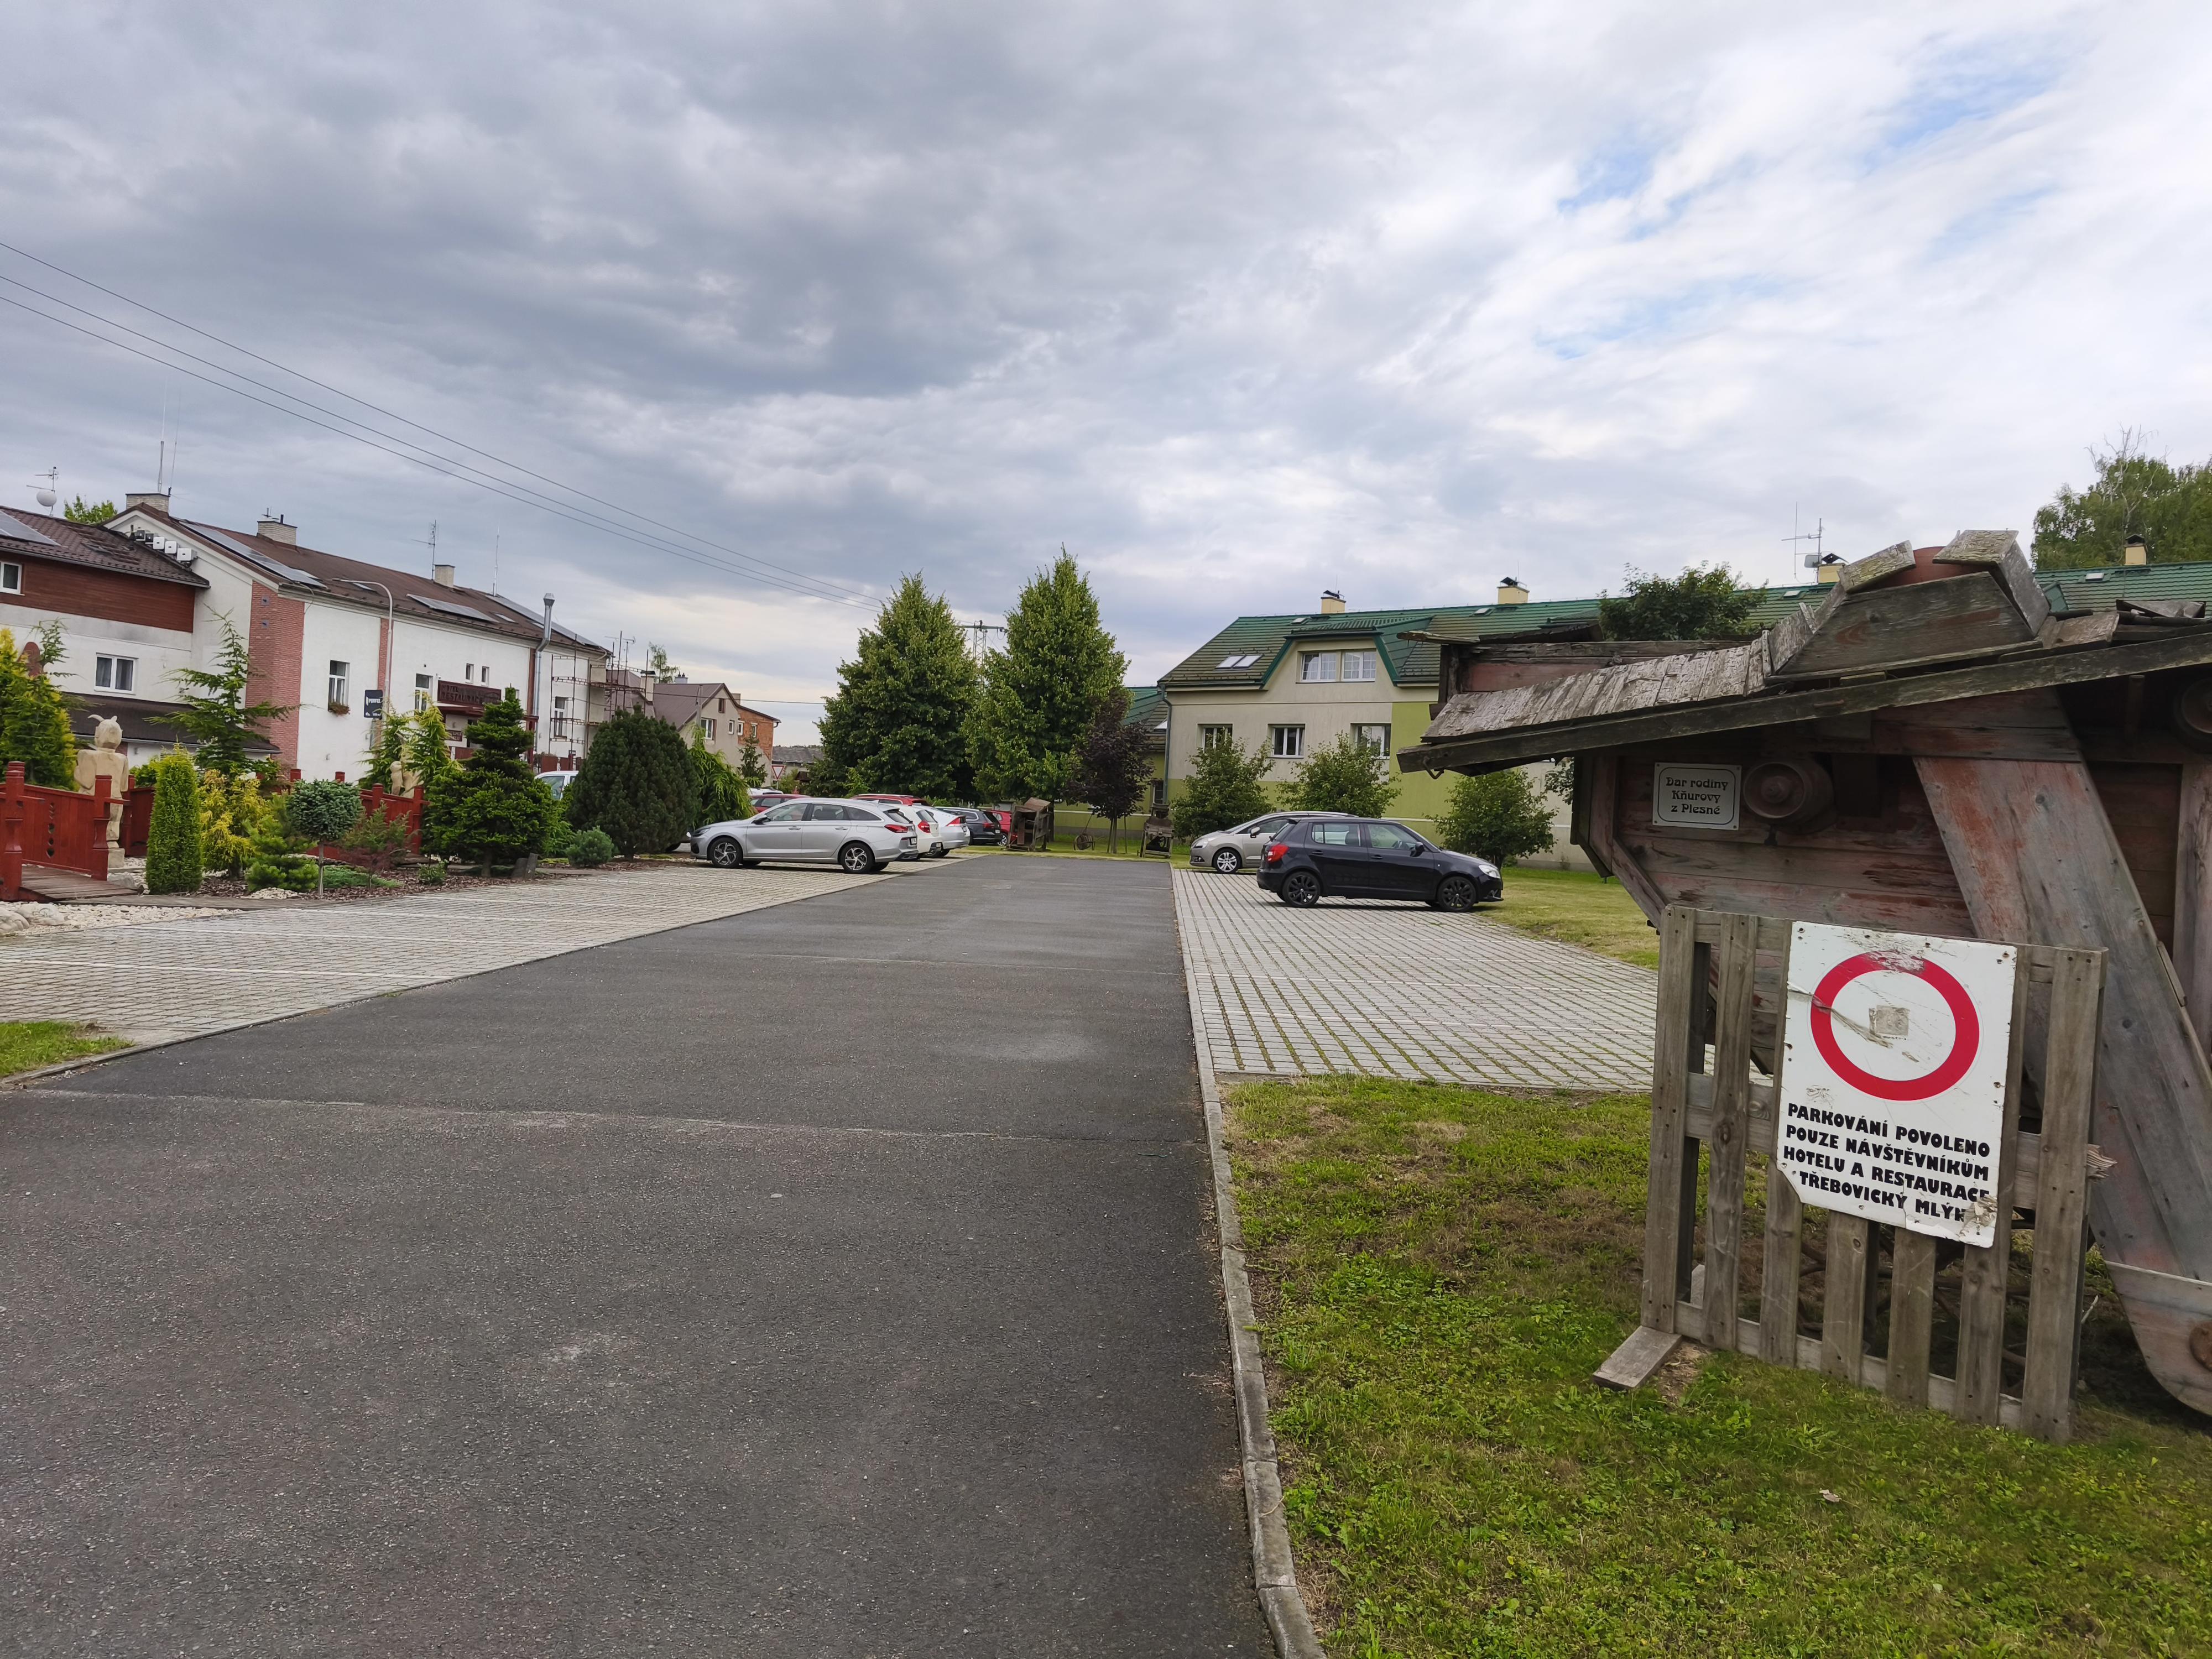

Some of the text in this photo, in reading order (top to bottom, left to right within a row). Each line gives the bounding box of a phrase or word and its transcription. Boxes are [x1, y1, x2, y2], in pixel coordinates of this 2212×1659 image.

[1666, 776, 1729, 791] Dar rodiny
[1672, 790, 1721, 804] Kňurovy
[1681, 804, 1720, 815] Plesné
[1788, 1103, 1990, 1157] PARKOVÁNÍ POVOLENO
[1783, 1145, 1845, 1172] HOTELU
[1850, 1162, 1864, 1178] A
[1786, 1124, 1989, 1182] POUZE NÁVŠTĚVNÍKŮM
[1799, 1170, 1908, 1209] TŘEBOVICKÝ
